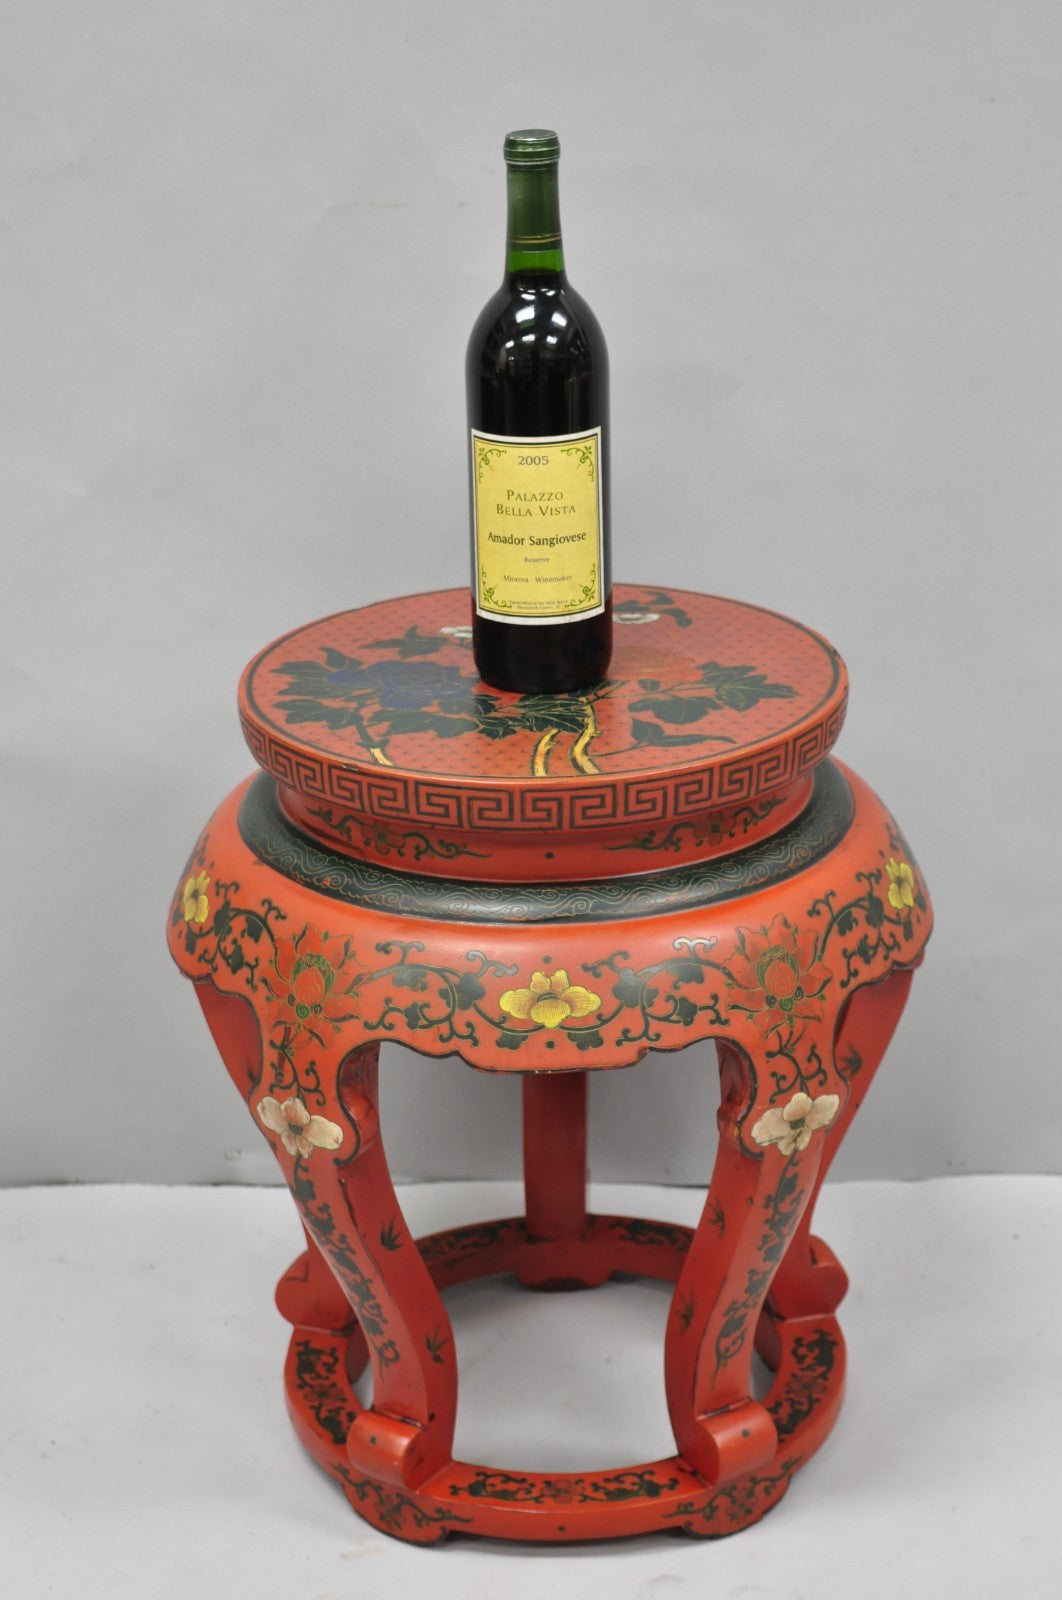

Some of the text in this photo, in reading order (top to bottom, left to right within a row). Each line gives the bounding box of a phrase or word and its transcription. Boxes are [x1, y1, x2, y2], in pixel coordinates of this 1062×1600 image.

[518, 455, 549, 466] 2005
[507, 489, 564, 502] PALAZZO
[496, 503, 576, 516] BELLA VISTA
[488, 532, 587, 547] Amador Sangiovese
[503, 575, 529, 583] Minerva
[535, 575, 573, 583] Winemaker
